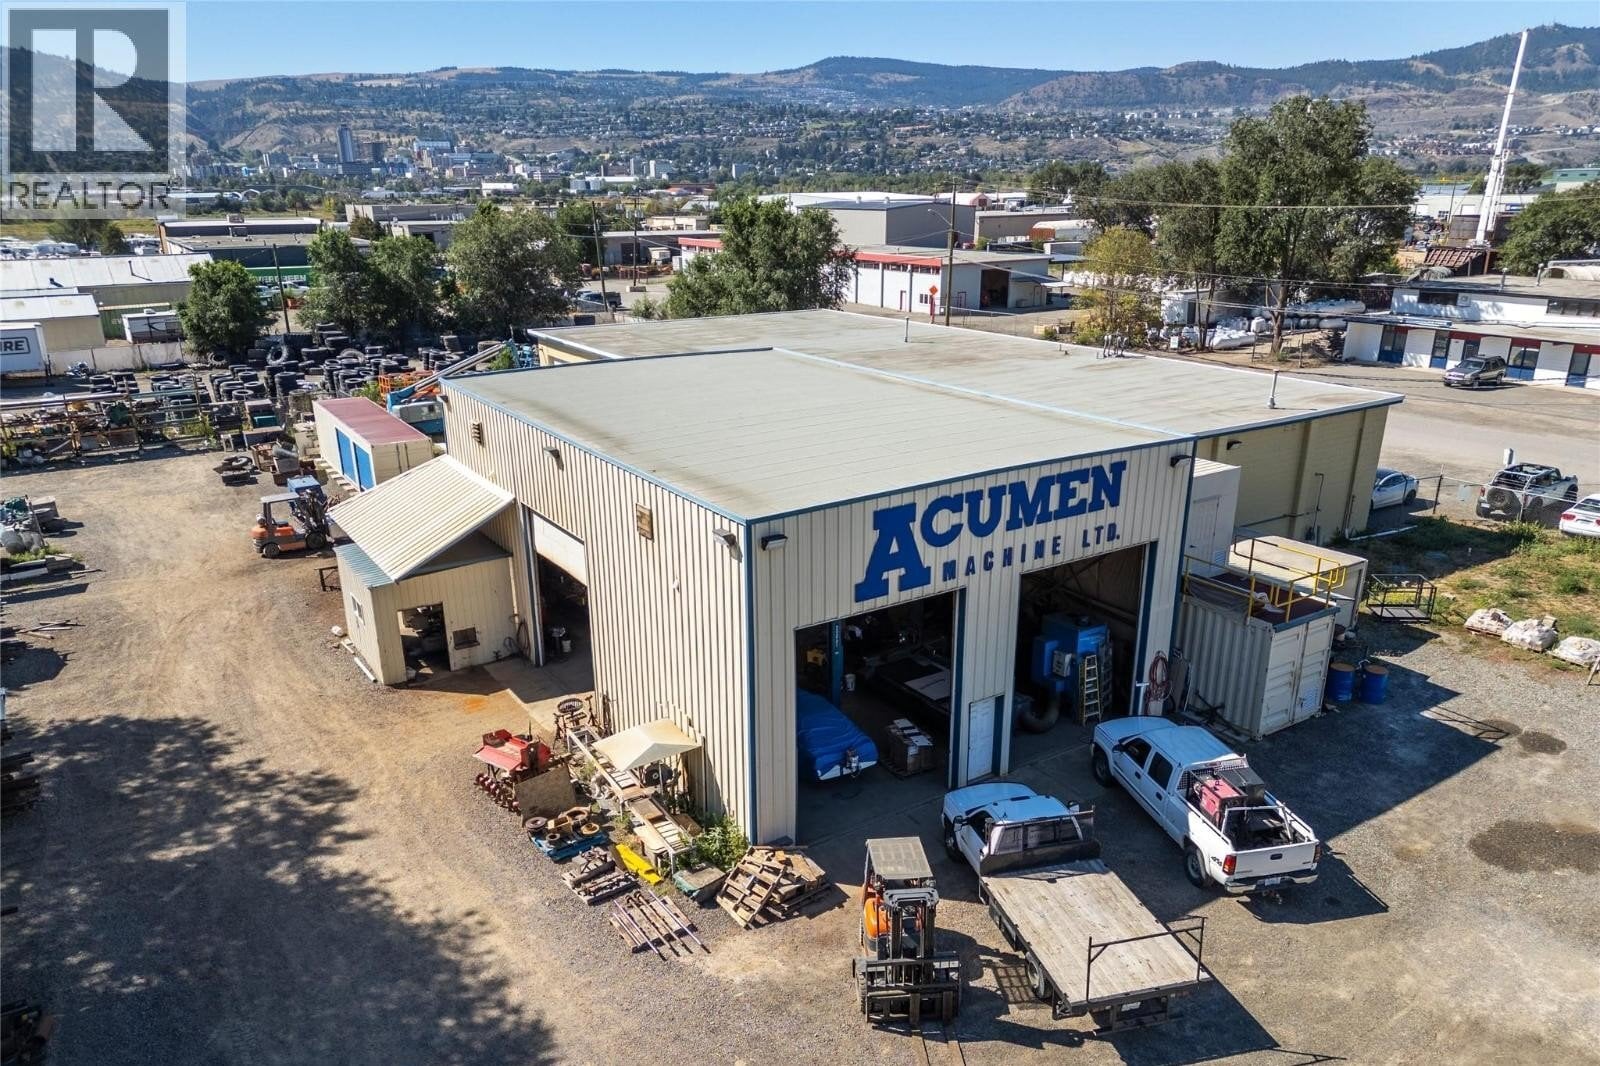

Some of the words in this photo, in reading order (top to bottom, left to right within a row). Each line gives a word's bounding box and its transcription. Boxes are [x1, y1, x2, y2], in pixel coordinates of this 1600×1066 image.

[855, 460, 1127, 602] ACUMEN
[942, 535, 1062, 582] MACHINE
[1082, 522, 1121, 548] LTD.
